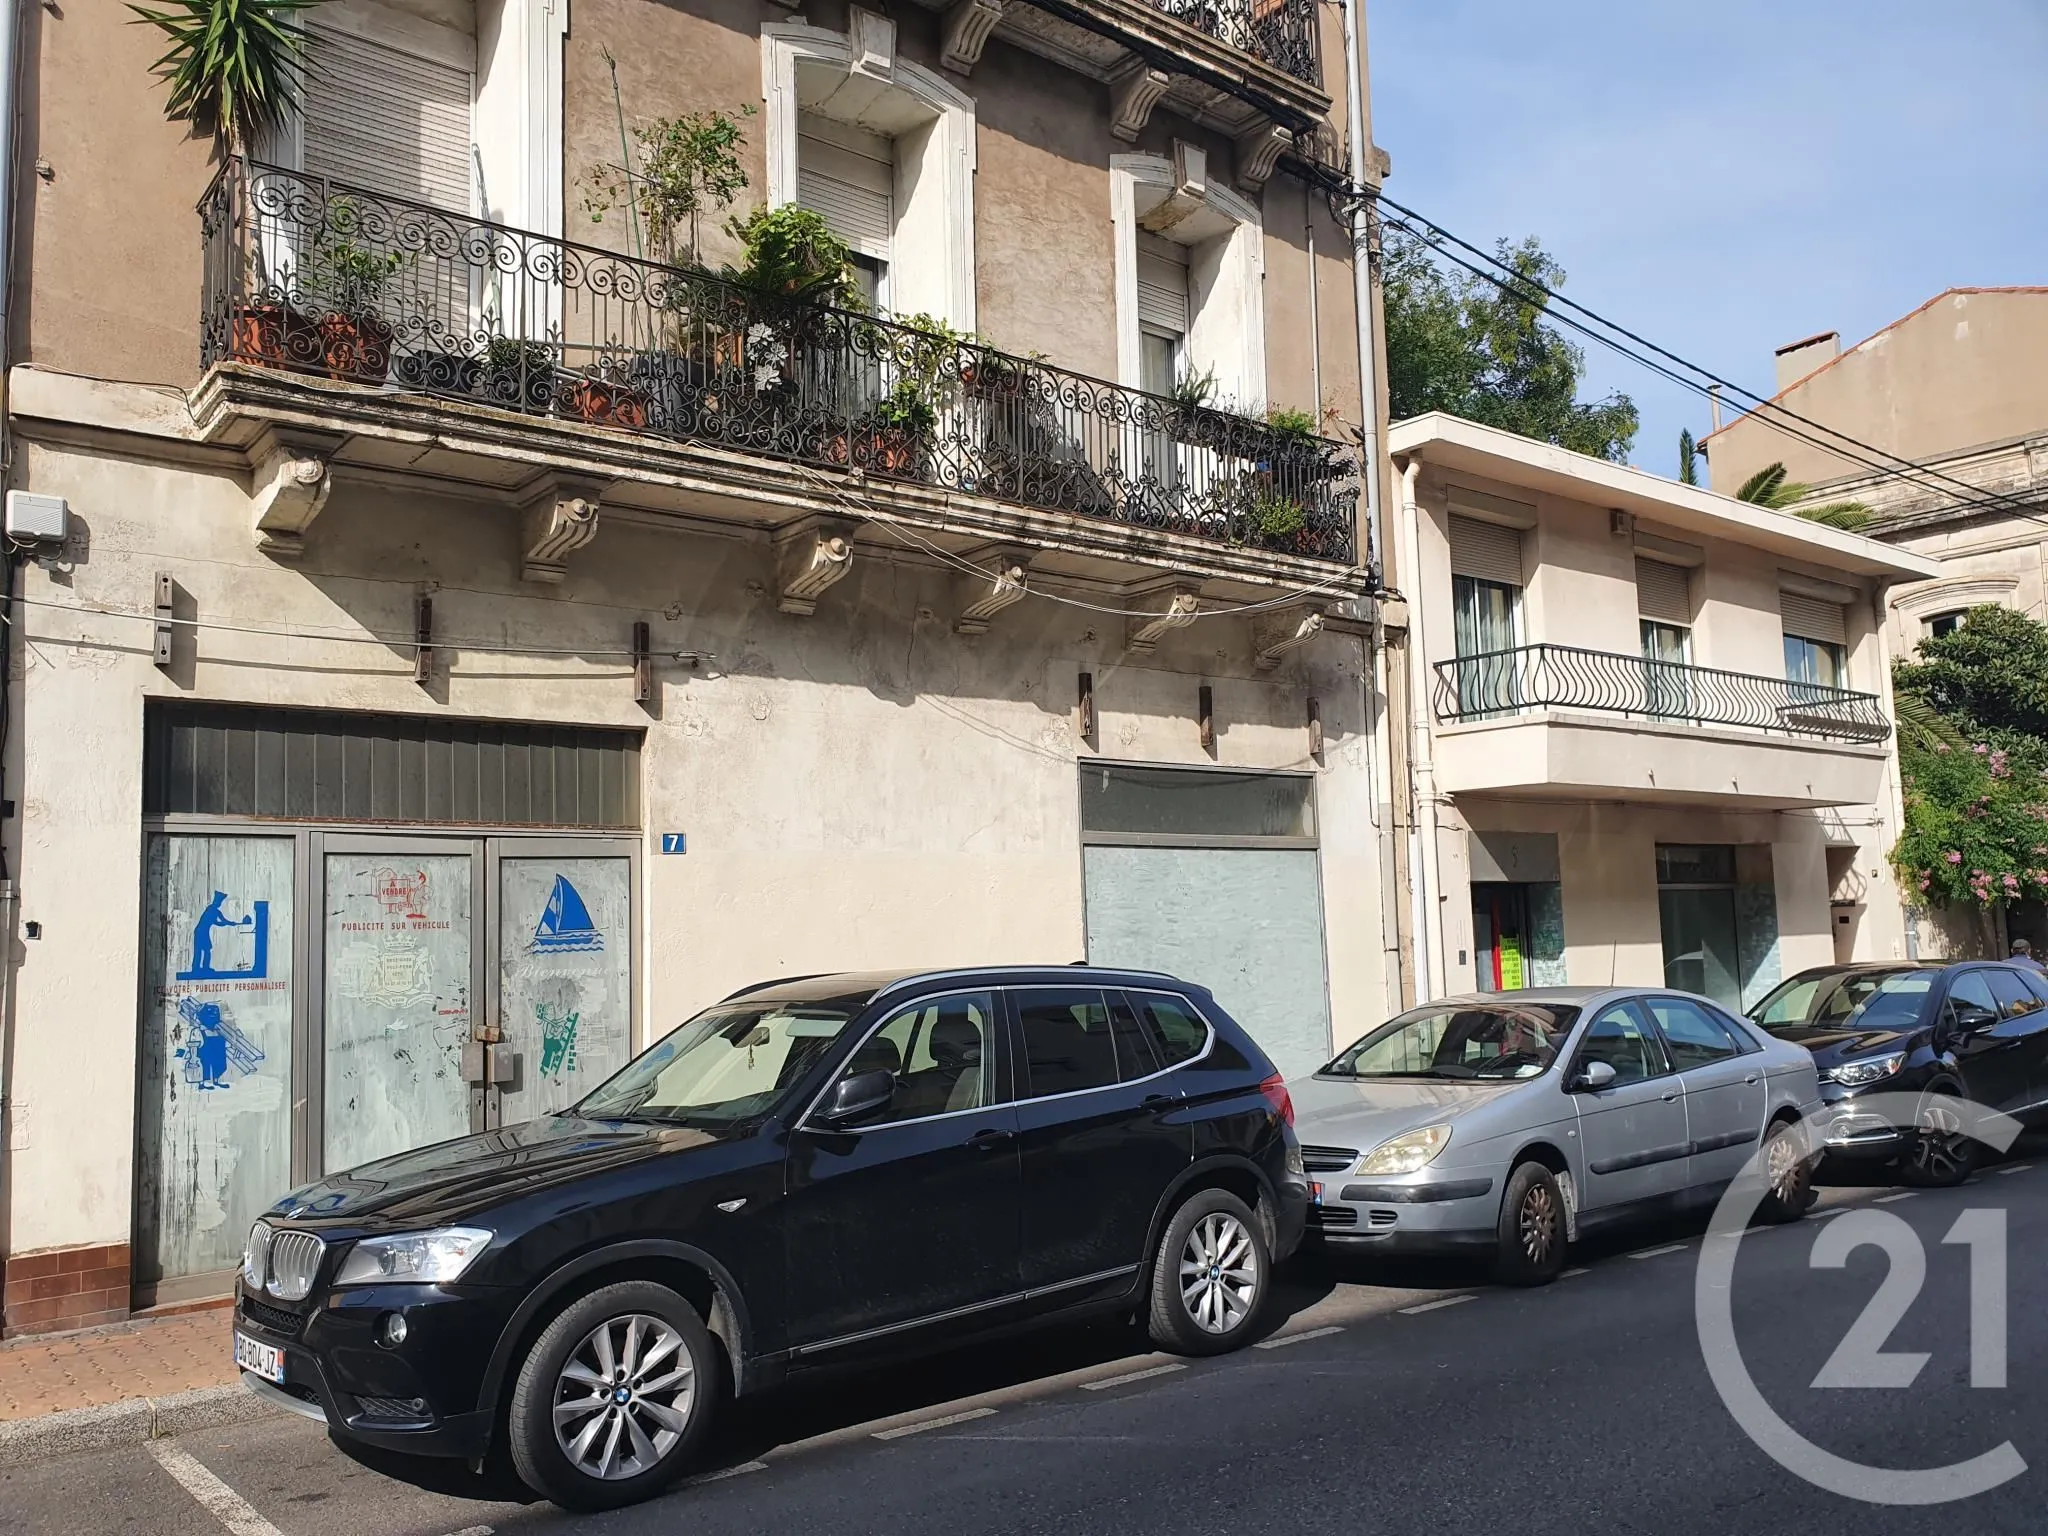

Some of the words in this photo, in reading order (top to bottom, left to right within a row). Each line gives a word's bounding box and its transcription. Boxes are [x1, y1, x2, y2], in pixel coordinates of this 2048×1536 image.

[668, 834, 679, 852] 7
[390, 880, 396, 888] A
[381, 887, 407, 896] VENDRE
[341, 922, 385, 931] PUBLICITE
[391, 922, 407, 930] SUR
[412, 921, 450, 930] VEHICULE
[168, 984, 190, 994] VOTRE
[195, 983, 230, 993] PUBLICITE
[234, 981, 286, 992] PERSONNALISEE
